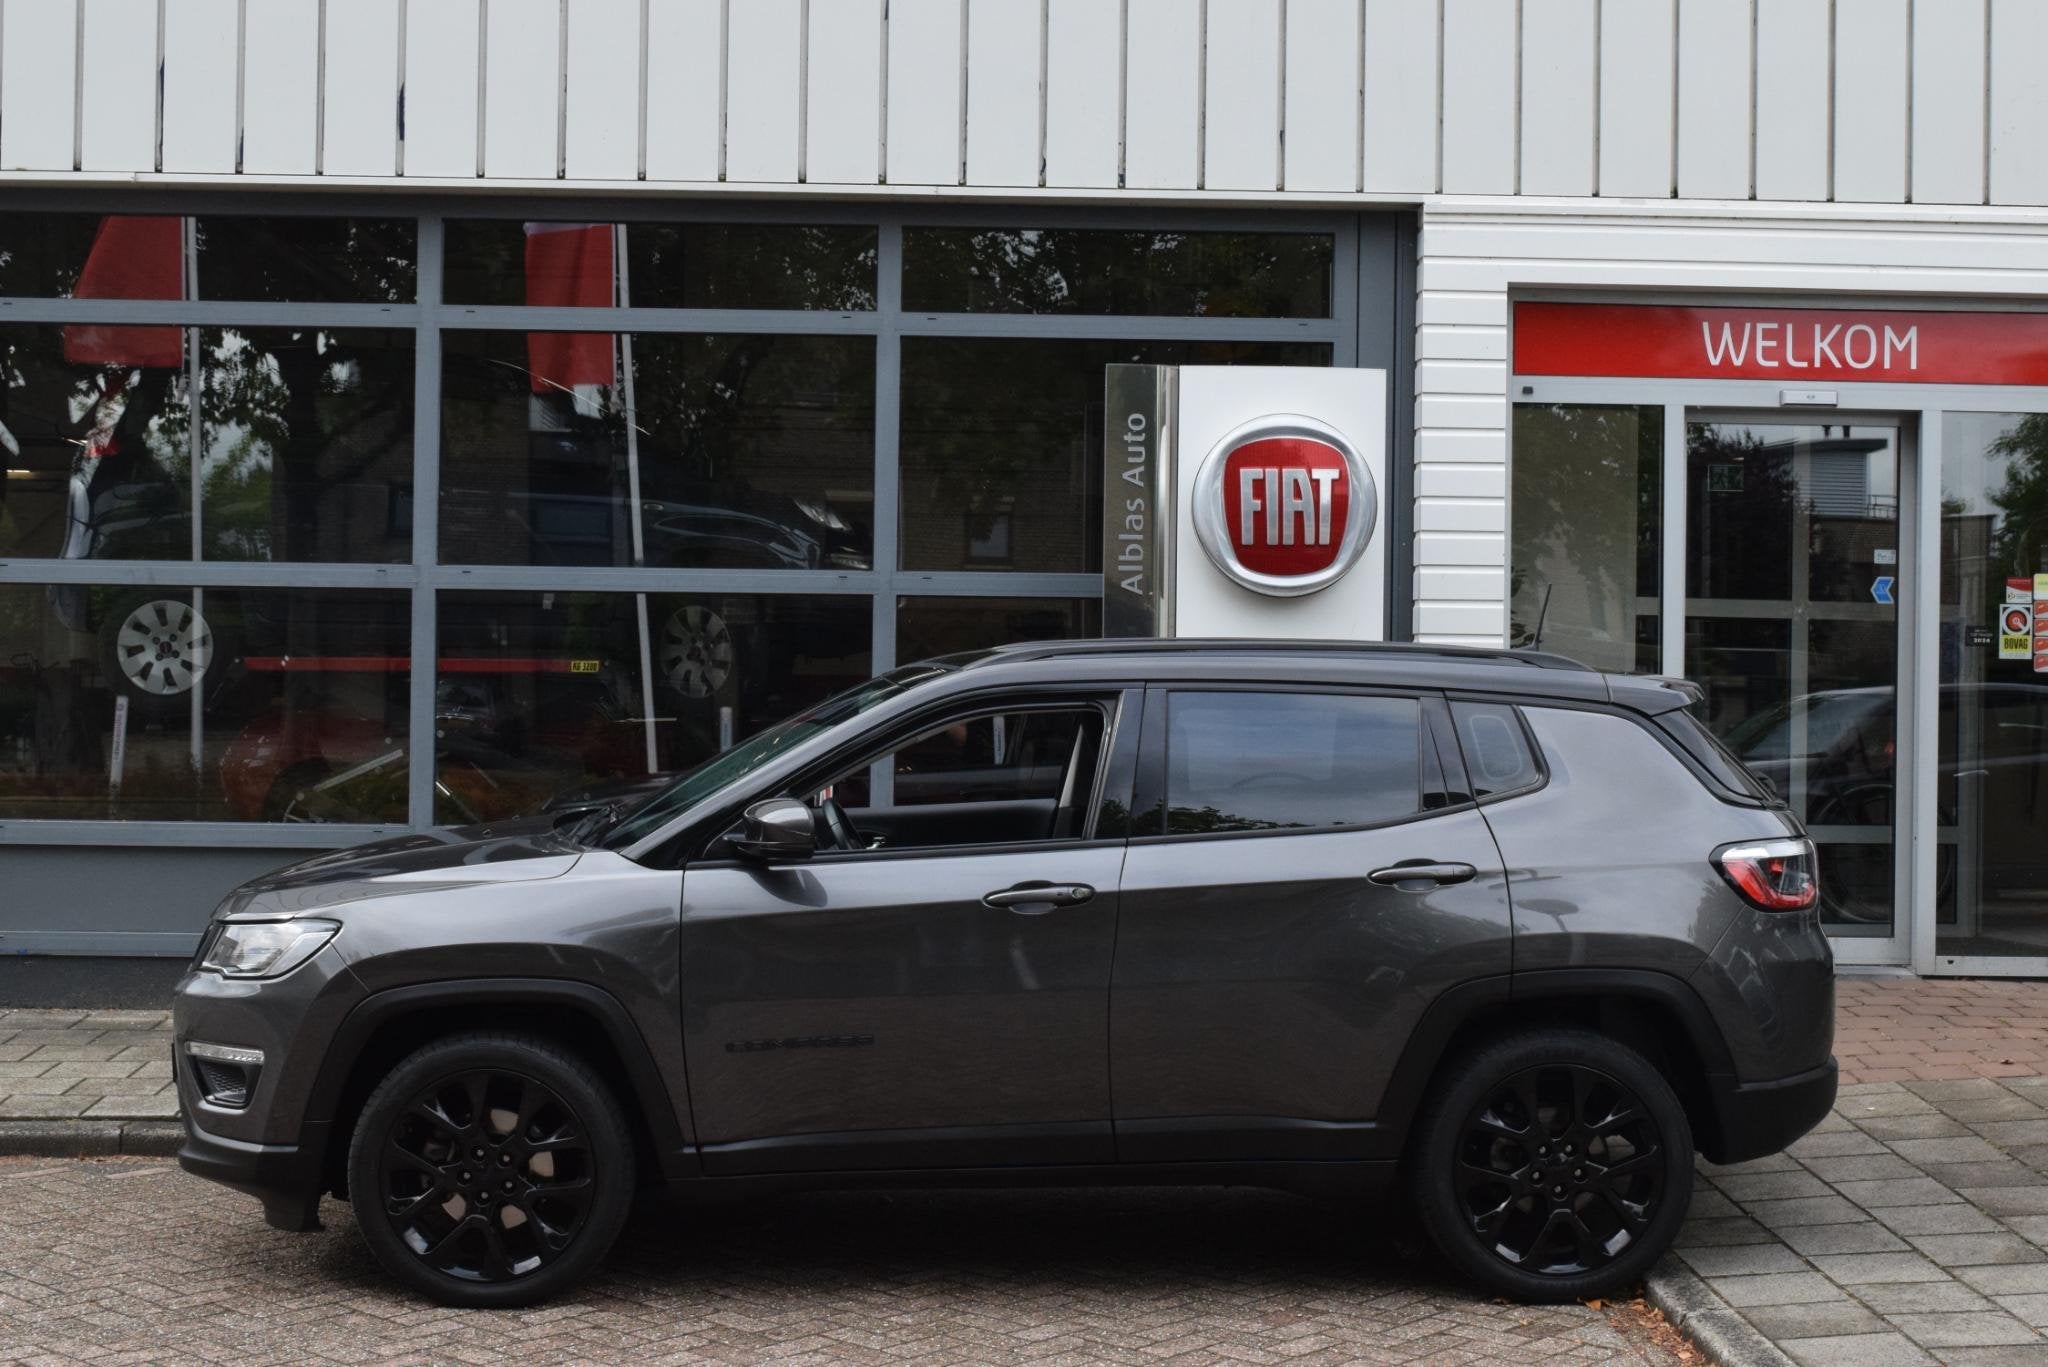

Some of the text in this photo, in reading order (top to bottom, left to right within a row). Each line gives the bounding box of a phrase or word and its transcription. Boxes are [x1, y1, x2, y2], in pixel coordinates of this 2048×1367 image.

[1702, 321, 1918, 370] WELKOM
[1118, 413, 1146, 595] Alblas Auto
[1239, 467, 1340, 547] FIAT
[2004, 638, 2028, 650] BOVAG
